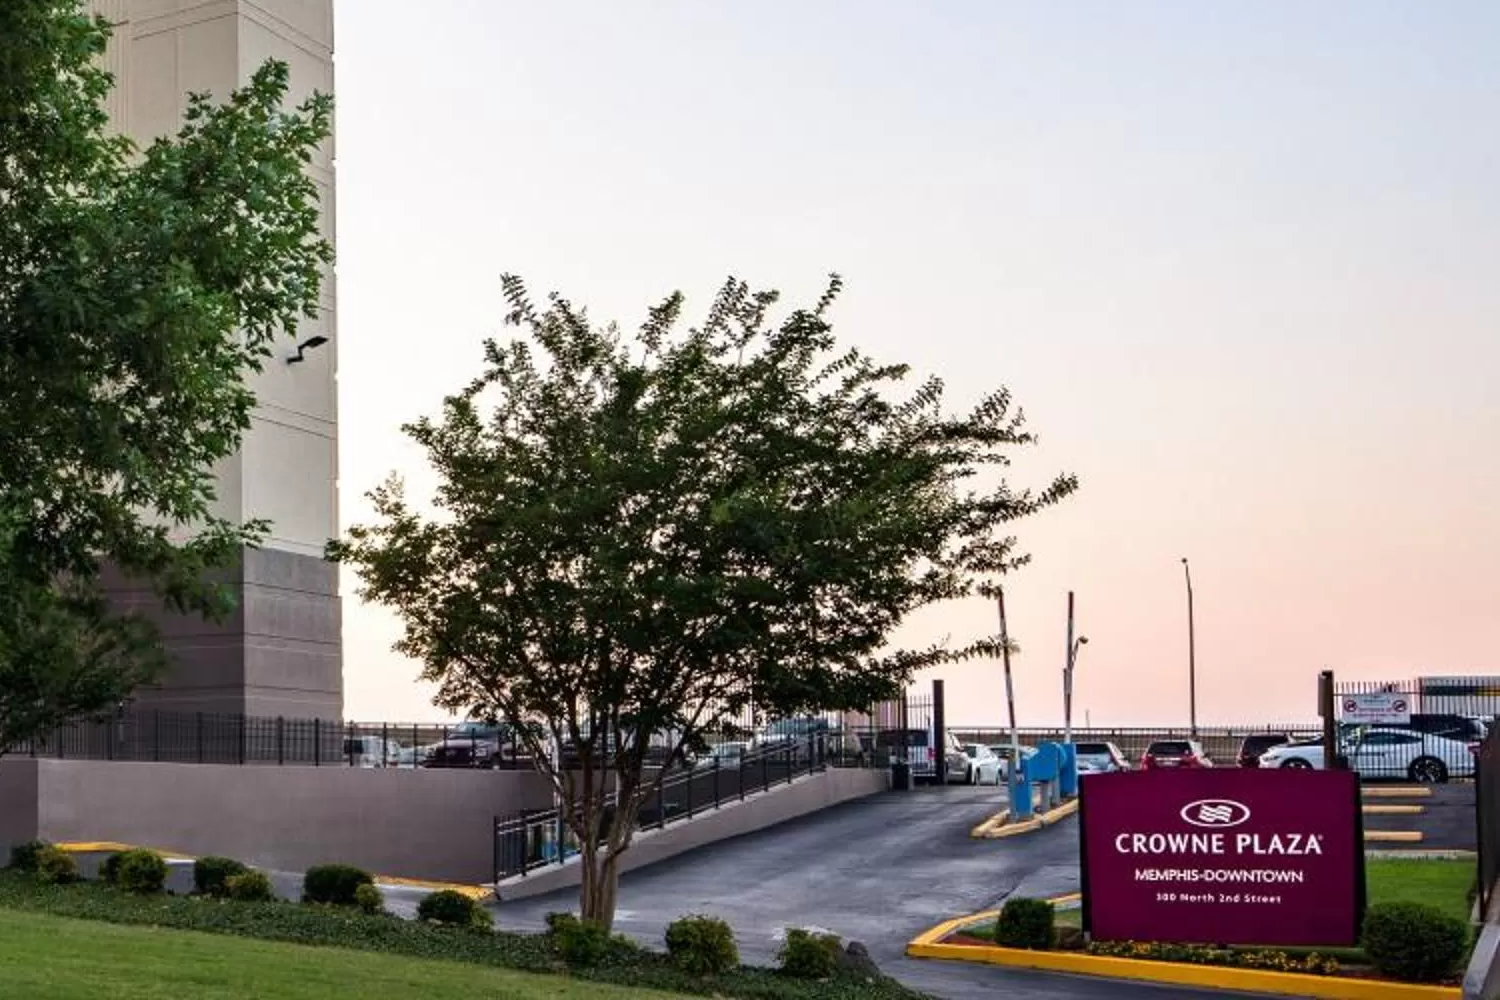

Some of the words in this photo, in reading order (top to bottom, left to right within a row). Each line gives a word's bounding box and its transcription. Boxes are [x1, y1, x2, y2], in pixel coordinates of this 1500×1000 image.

[1115, 833, 1225, 854] CROWNE
[1236, 833, 1323, 855] PLAZA
[1134, 868, 1304, 883] MEMPHIS-DOWNTOWN
[1180, 893, 1215, 903] North
[1219, 893, 1241, 903] 2nd
[1243, 893, 1282, 904] Street
